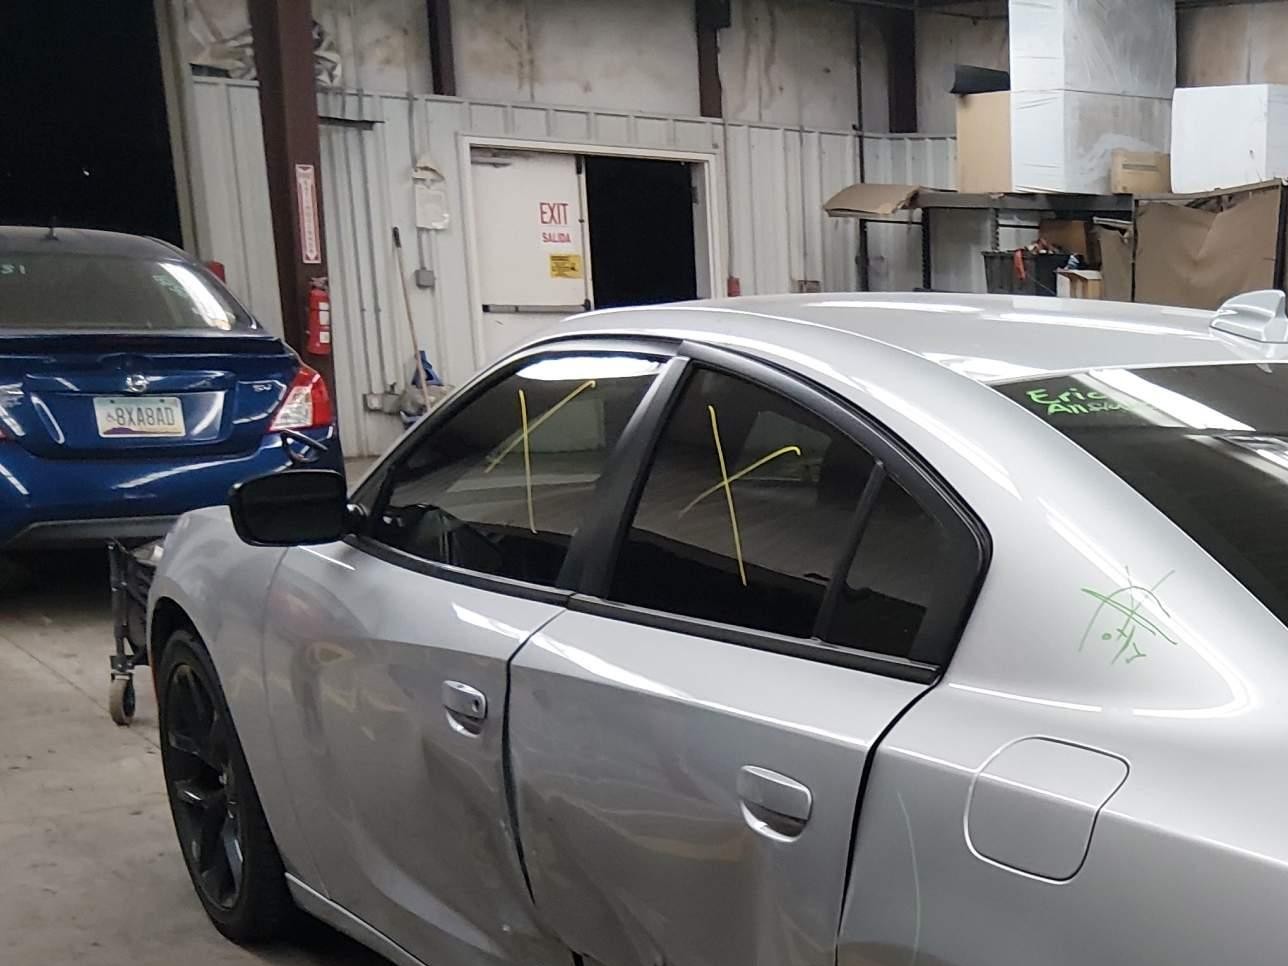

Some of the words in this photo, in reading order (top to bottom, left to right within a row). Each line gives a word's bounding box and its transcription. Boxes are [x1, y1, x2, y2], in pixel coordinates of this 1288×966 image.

[539, 202, 568, 225] EXIT
[541, 232, 571, 243] SALIDA
[1026, 387, 1107, 405] Eric
[115, 407, 176, 427] 8XA8AD
